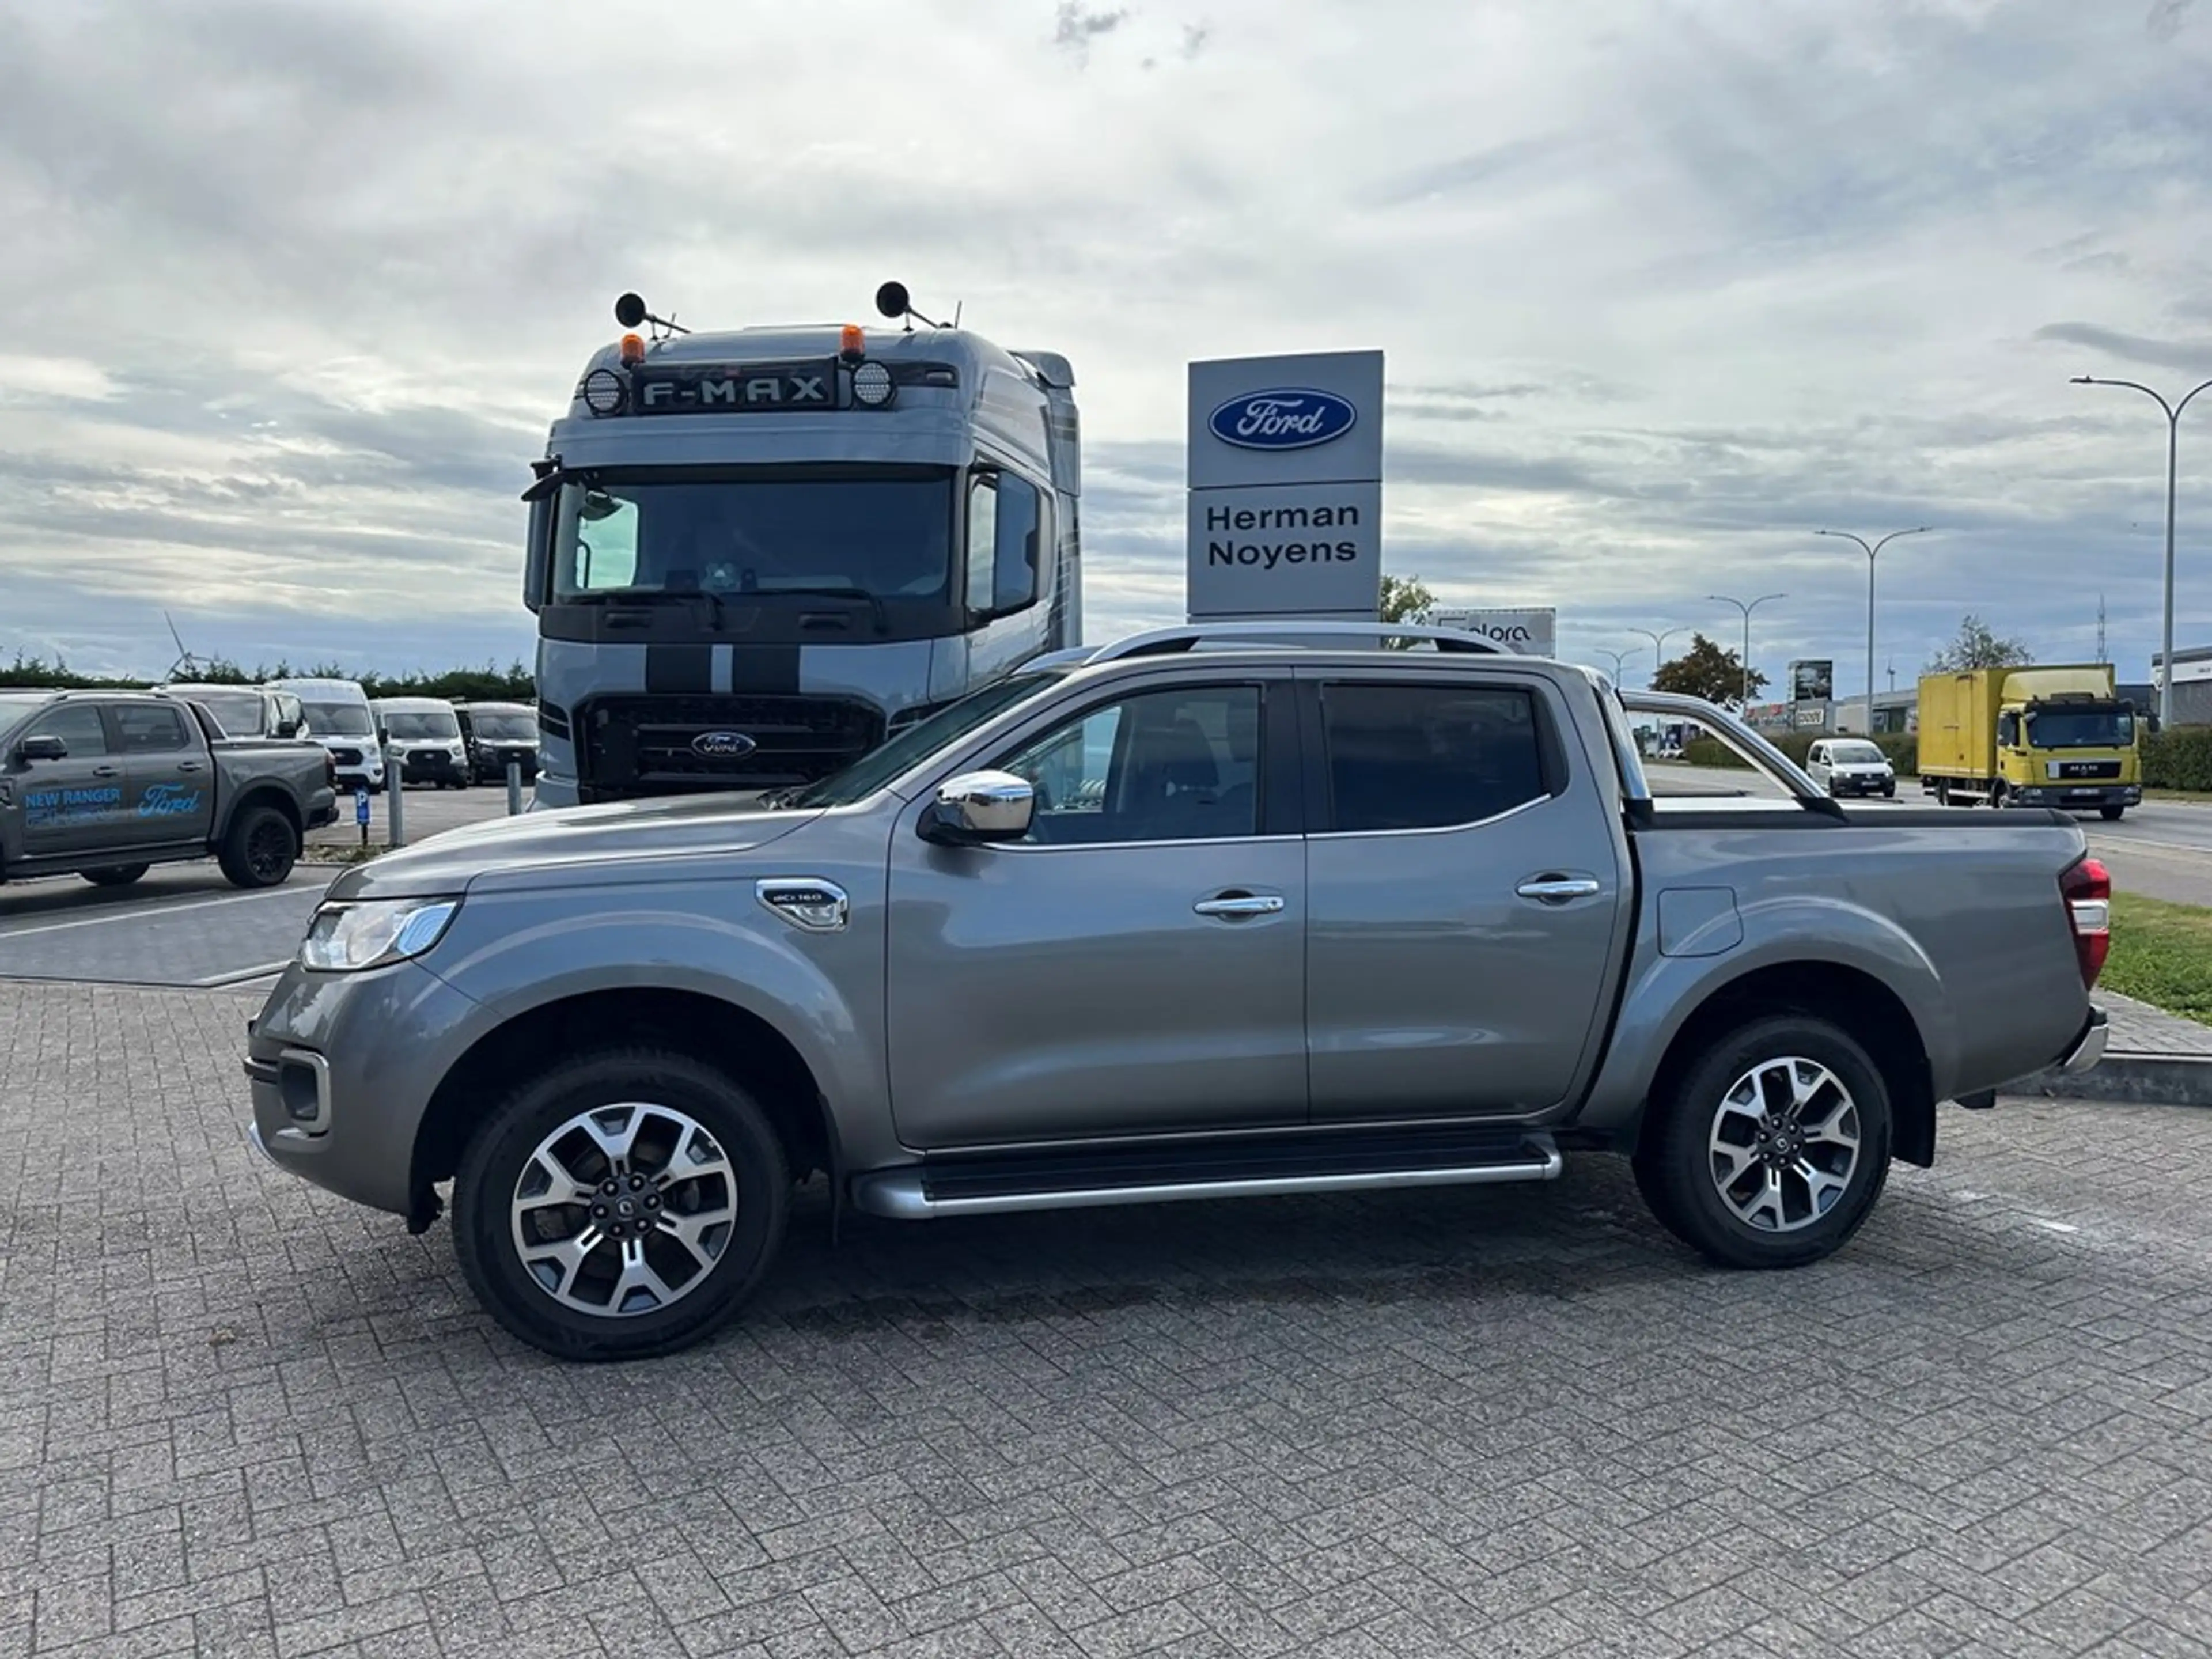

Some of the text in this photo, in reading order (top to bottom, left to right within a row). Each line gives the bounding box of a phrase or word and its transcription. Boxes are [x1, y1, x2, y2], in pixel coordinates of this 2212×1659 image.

[643, 377, 823, 405] F-MAX
[1236, 399, 1325, 435] Ford
[1207, 505, 1359, 531] Herman
[1209, 540, 1357, 570] Noyens
[25, 787, 120, 808] NEW RANGER
[138, 784, 200, 818] Ford
